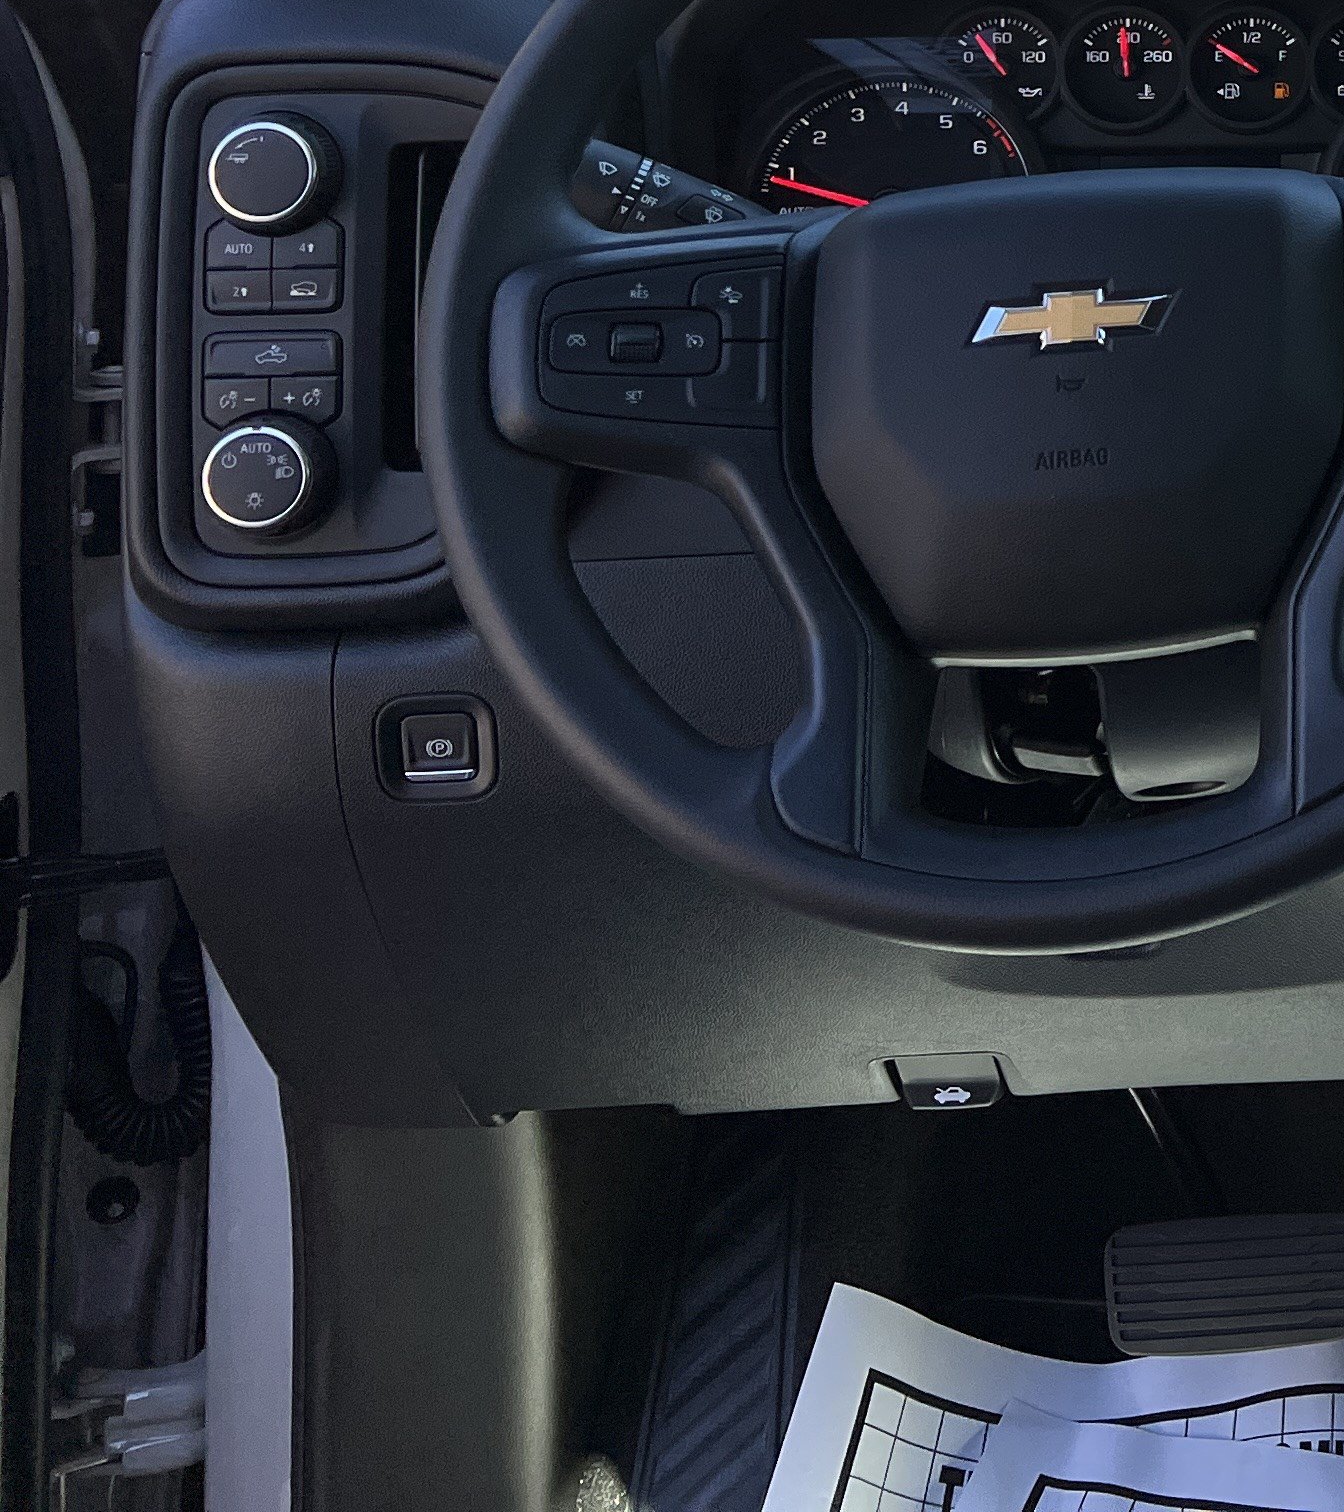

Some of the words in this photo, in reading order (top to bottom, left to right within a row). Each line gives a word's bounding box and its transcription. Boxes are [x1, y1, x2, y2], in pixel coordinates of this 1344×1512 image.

[992, 32, 1012, 44] 60
[1242, 31, 1262, 44] 1/2
[963, 51, 974, 64] 0
[1021, 51, 1046, 64] 120
[1086, 51, 1109, 64] 160
[1143, 51, 1173, 63] 260
[1214, 51, 1224, 64] E
[1278, 50, 1288, 62] F
[850, 107, 866, 123] 3
[895, 101, 910, 116] 4
[939, 115, 954, 129] 5
[813, 130, 828, 146] 2
[973, 140, 988, 156] 6
[787, 167, 796, 181] 1
[641, 194, 659, 207] OFF
[224, 243, 253, 255] AUTO
[630, 289, 650, 299] RES
[626, 390, 644, 401] SET
[240, 441, 272, 456] AUTO
[1035, 448, 1109, 471] AIRBAG
